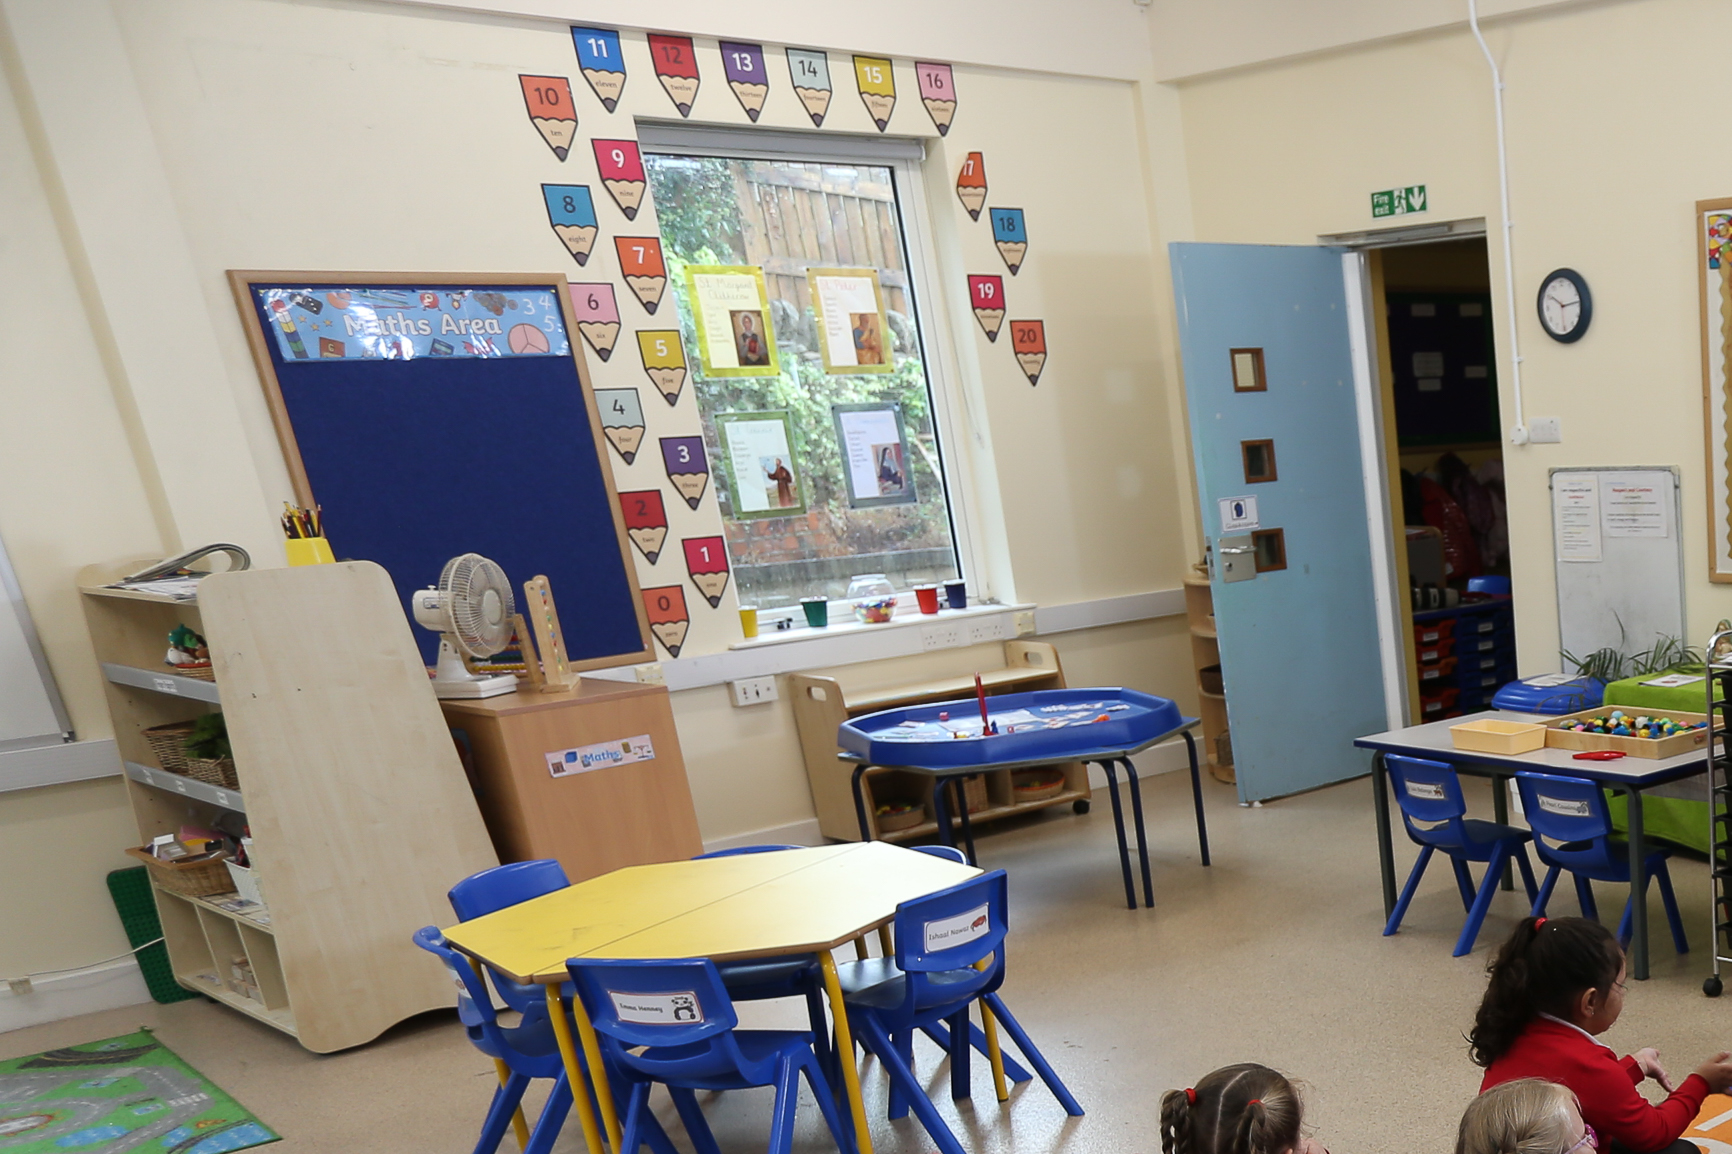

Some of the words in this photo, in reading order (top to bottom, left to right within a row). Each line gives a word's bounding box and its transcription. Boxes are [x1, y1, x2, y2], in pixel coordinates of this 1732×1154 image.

[587, 38, 609, 58] 11
[661, 46, 684, 65] 12
[732, 52, 754, 72] 13
[798, 60, 818, 77] 14
[863, 66, 883, 84] 15
[926, 72, 944, 90] 16
[534, 87, 559, 106] 10
[611, 149, 625, 168] 9
[563, 195, 576, 213] 8
[1373, 194, 1389, 205] Fire
[1374, 205, 1390, 216] exit
[999, 217, 1016, 232] 18
[632, 246, 645, 264] 7
[978, 282, 995, 299] 19
[523, 298, 536, 315] 3
[538, 295, 552, 310] 4
[587, 293, 599, 310] 6
[441, 313, 503, 337] Area
[543, 315, 557, 333] 5
[1018, 328, 1037, 344] 20
[655, 340, 668, 357] 5
[612, 399, 625, 415] 4
[677, 445, 691, 463] 3
[635, 500, 648, 517] 2
[700, 546, 710, 563] 1
[658, 595, 670, 611] 0
[583, 750, 621, 763] Maths
